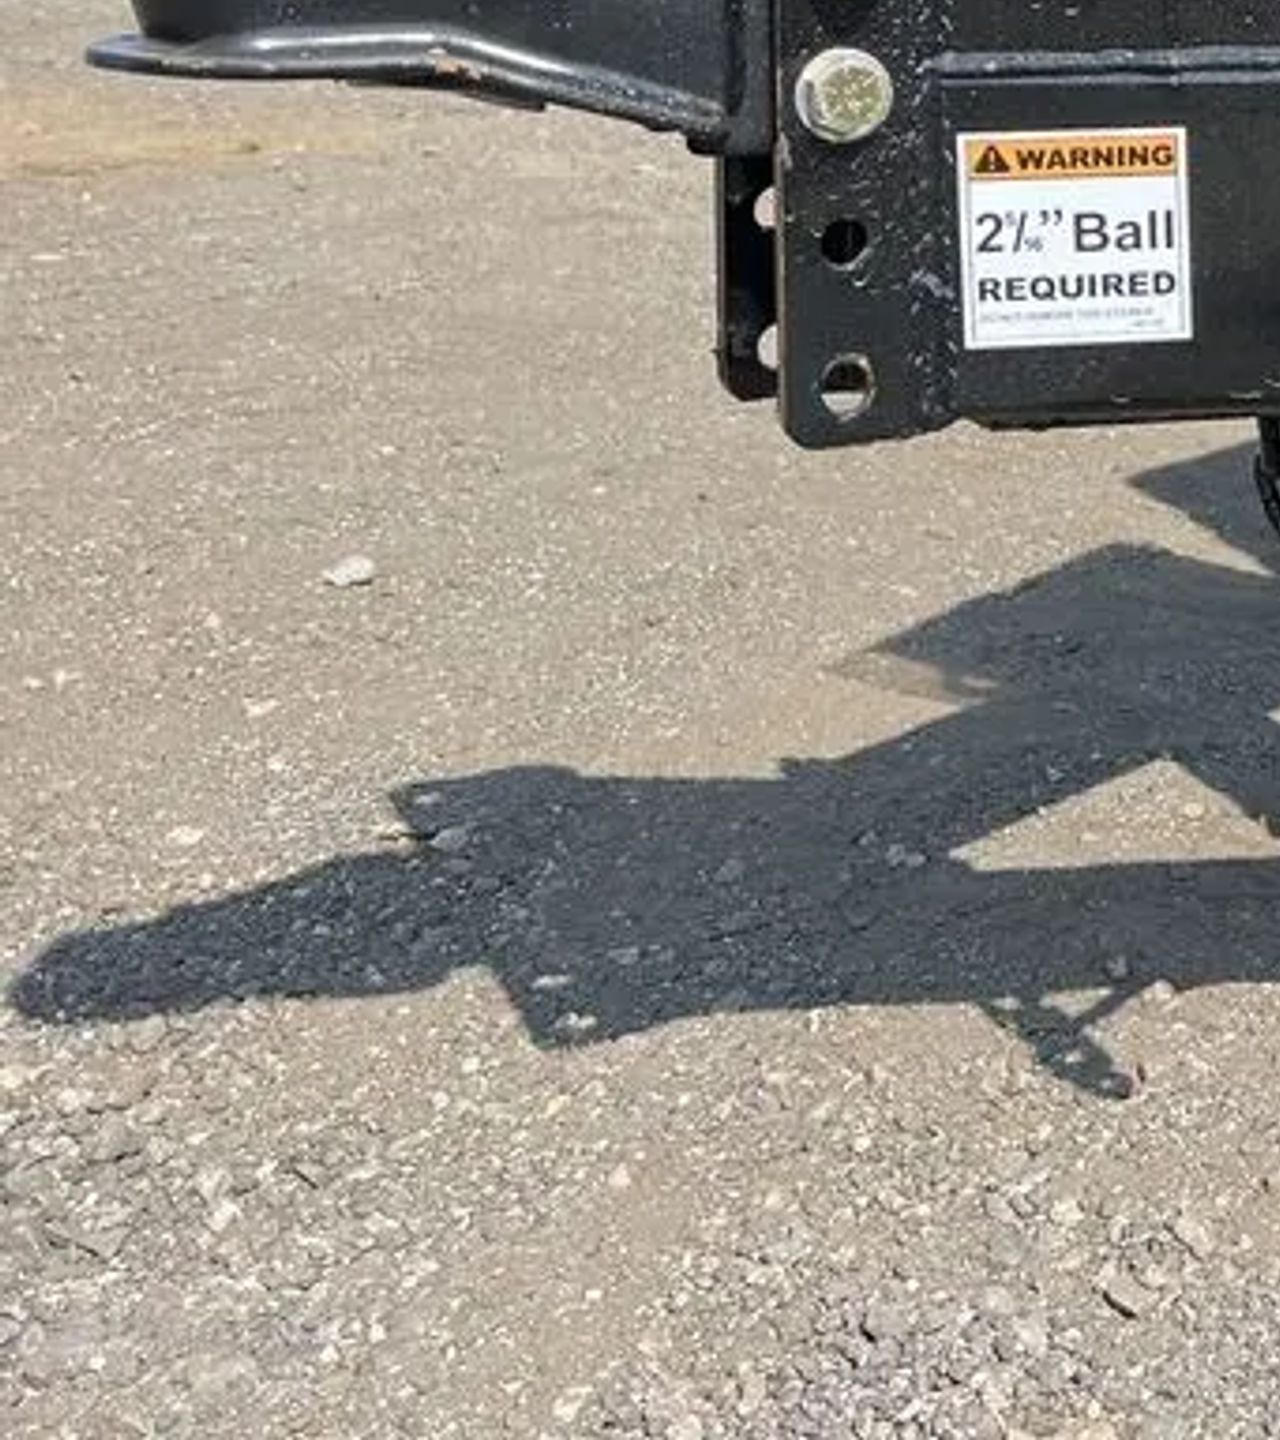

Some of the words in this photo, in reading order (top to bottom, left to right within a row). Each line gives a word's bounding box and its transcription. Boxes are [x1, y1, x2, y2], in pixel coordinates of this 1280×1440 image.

[1016, 145, 1174, 171] WARNING
[1073, 209, 1175, 253] Ball
[977, 270, 1176, 303] REQUIRED
